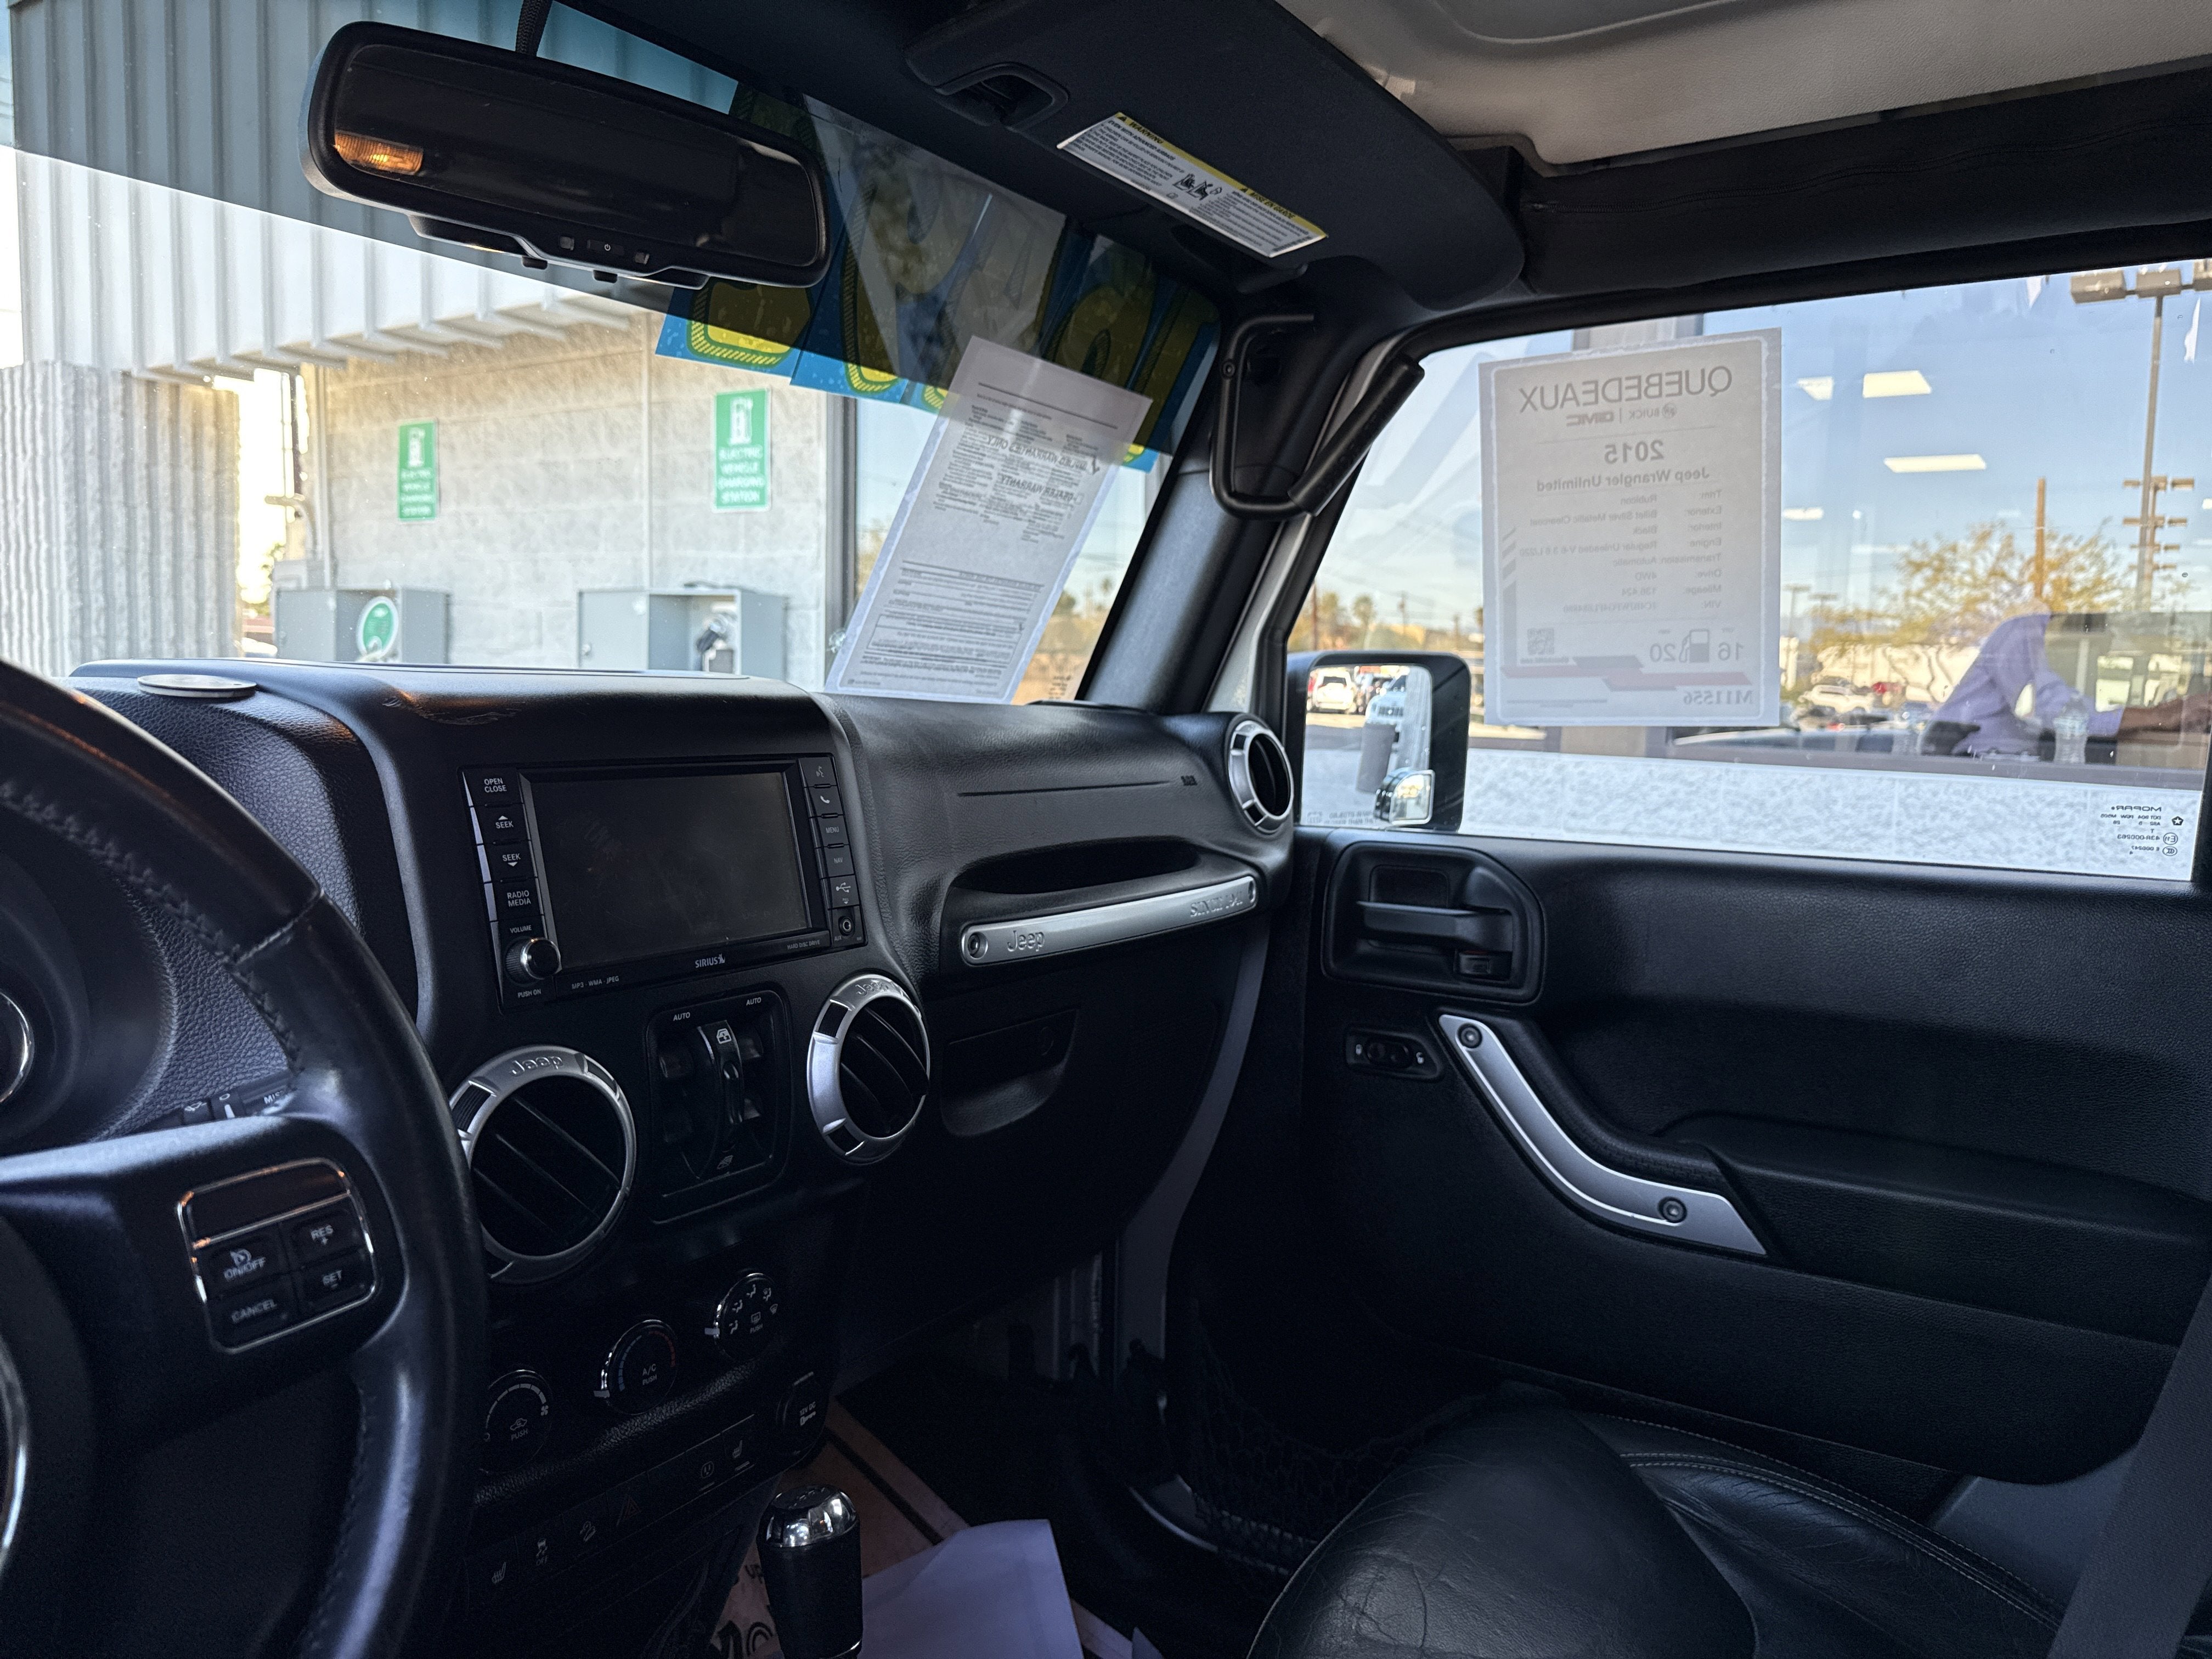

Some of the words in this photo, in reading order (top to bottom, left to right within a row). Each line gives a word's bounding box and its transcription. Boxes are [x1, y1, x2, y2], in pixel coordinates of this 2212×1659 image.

[1127, 122, 1165, 144] WARNING
[484, 785, 507, 793] CLOSE
[495, 821, 514, 829] SEEK
[502, 853, 521, 861] SEEK
[507, 890, 529, 899] RADIO
[508, 898, 532, 907] MEDIA
[510, 925, 532, 933] VOLUME
[1007, 930, 1045, 952] Jeep
[695, 957, 718, 968] SIRIUS
[588, 979, 602, 987] WMA
[606, 975, 619, 984] JPEG
[855, 980, 889, 996] Jeep
[746, 997, 761, 1006] AUTO
[673, 1012, 690, 1021] AUTO
[508, 1056, 563, 1076] Jeep
[263, 1090, 285, 1104] MIS
[311, 1224, 334, 1242] RES
[224, 1256, 267, 1280] ON/OFF
[323, 1270, 342, 1286] SET
[232, 1299, 277, 1324] CANCEL
[750, 1323, 763, 1334] PUSH
[642, 1363, 656, 1376] A/C
[642, 1374, 657, 1385] PUSH
[800, 1405, 808, 1415] 12V
[809, 1401, 816, 1410] DC
[511, 1428, 528, 1441] PUSH
